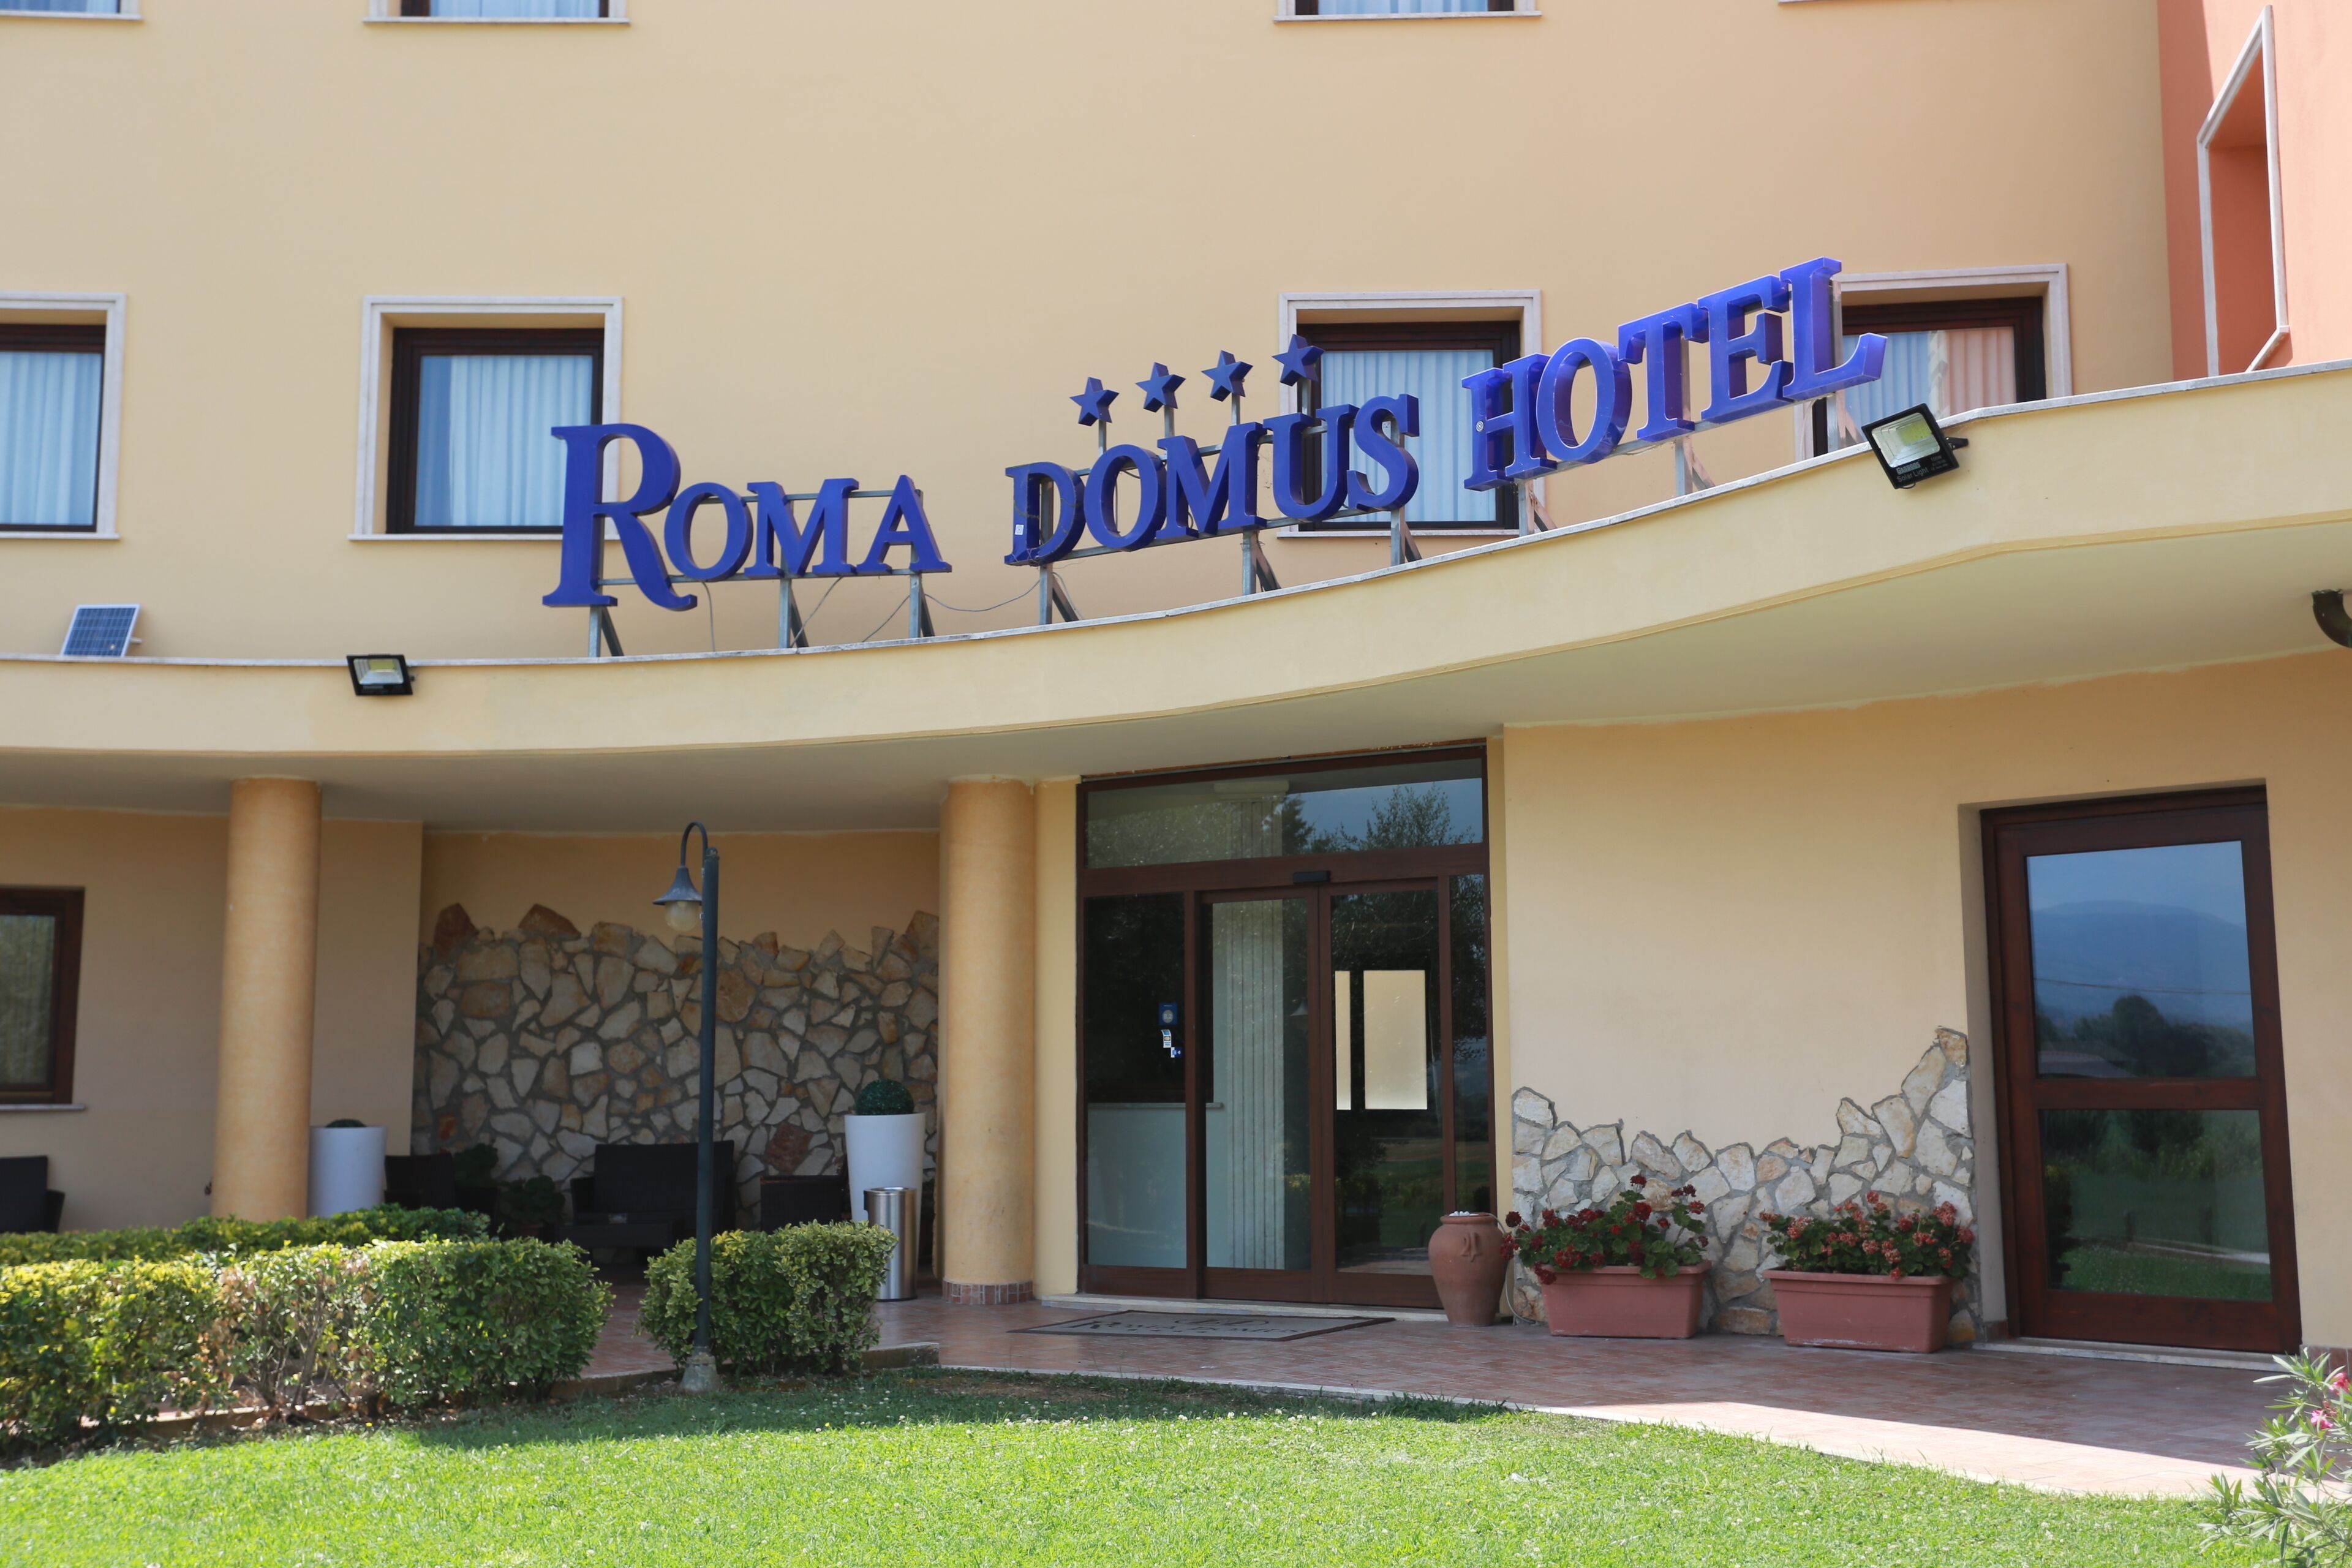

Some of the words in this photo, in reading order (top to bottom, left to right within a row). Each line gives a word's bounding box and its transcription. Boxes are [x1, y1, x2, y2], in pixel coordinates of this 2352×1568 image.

[542, 423, 952, 611] ROMA
[1005, 394, 1419, 566] DOMUS
[1461, 257, 1888, 491] HOTEL
[1897, 473, 1912, 482] Solar
[1912, 466, 1929, 477] Light
